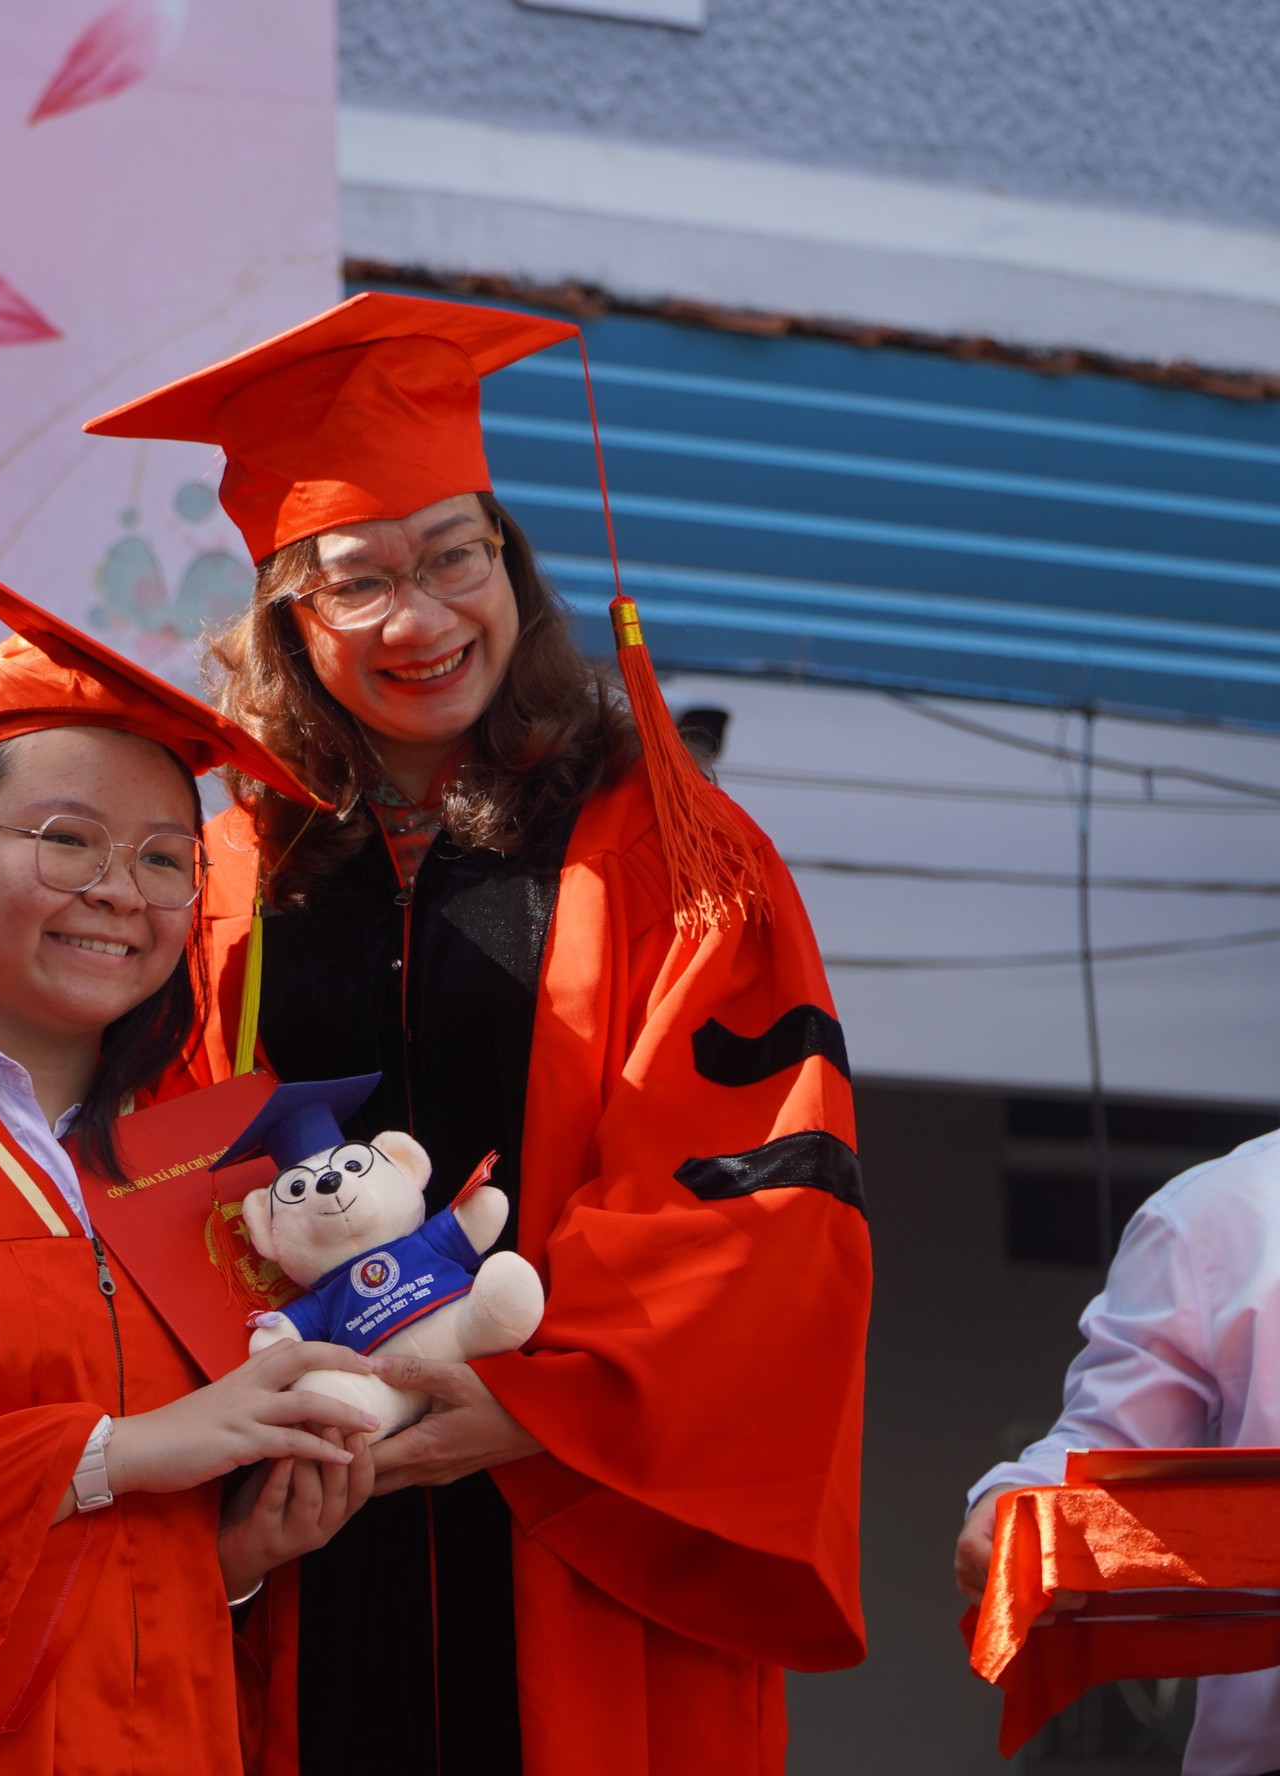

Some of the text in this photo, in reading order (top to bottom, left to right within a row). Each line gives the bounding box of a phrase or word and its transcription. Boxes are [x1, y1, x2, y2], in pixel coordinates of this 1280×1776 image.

[107, 1183, 136, 1199] CỘNG
[133, 1175, 157, 1190] HÒA
[154, 1168, 172, 1182] XÃ
[169, 1163, 189, 1177] HỘI
[187, 1154, 209, 1171] CHỦ
[415, 1274, 434, 1287] THCS
[391, 1298, 408, 1312] 2021
[412, 1288, 431, 1300] 2025
